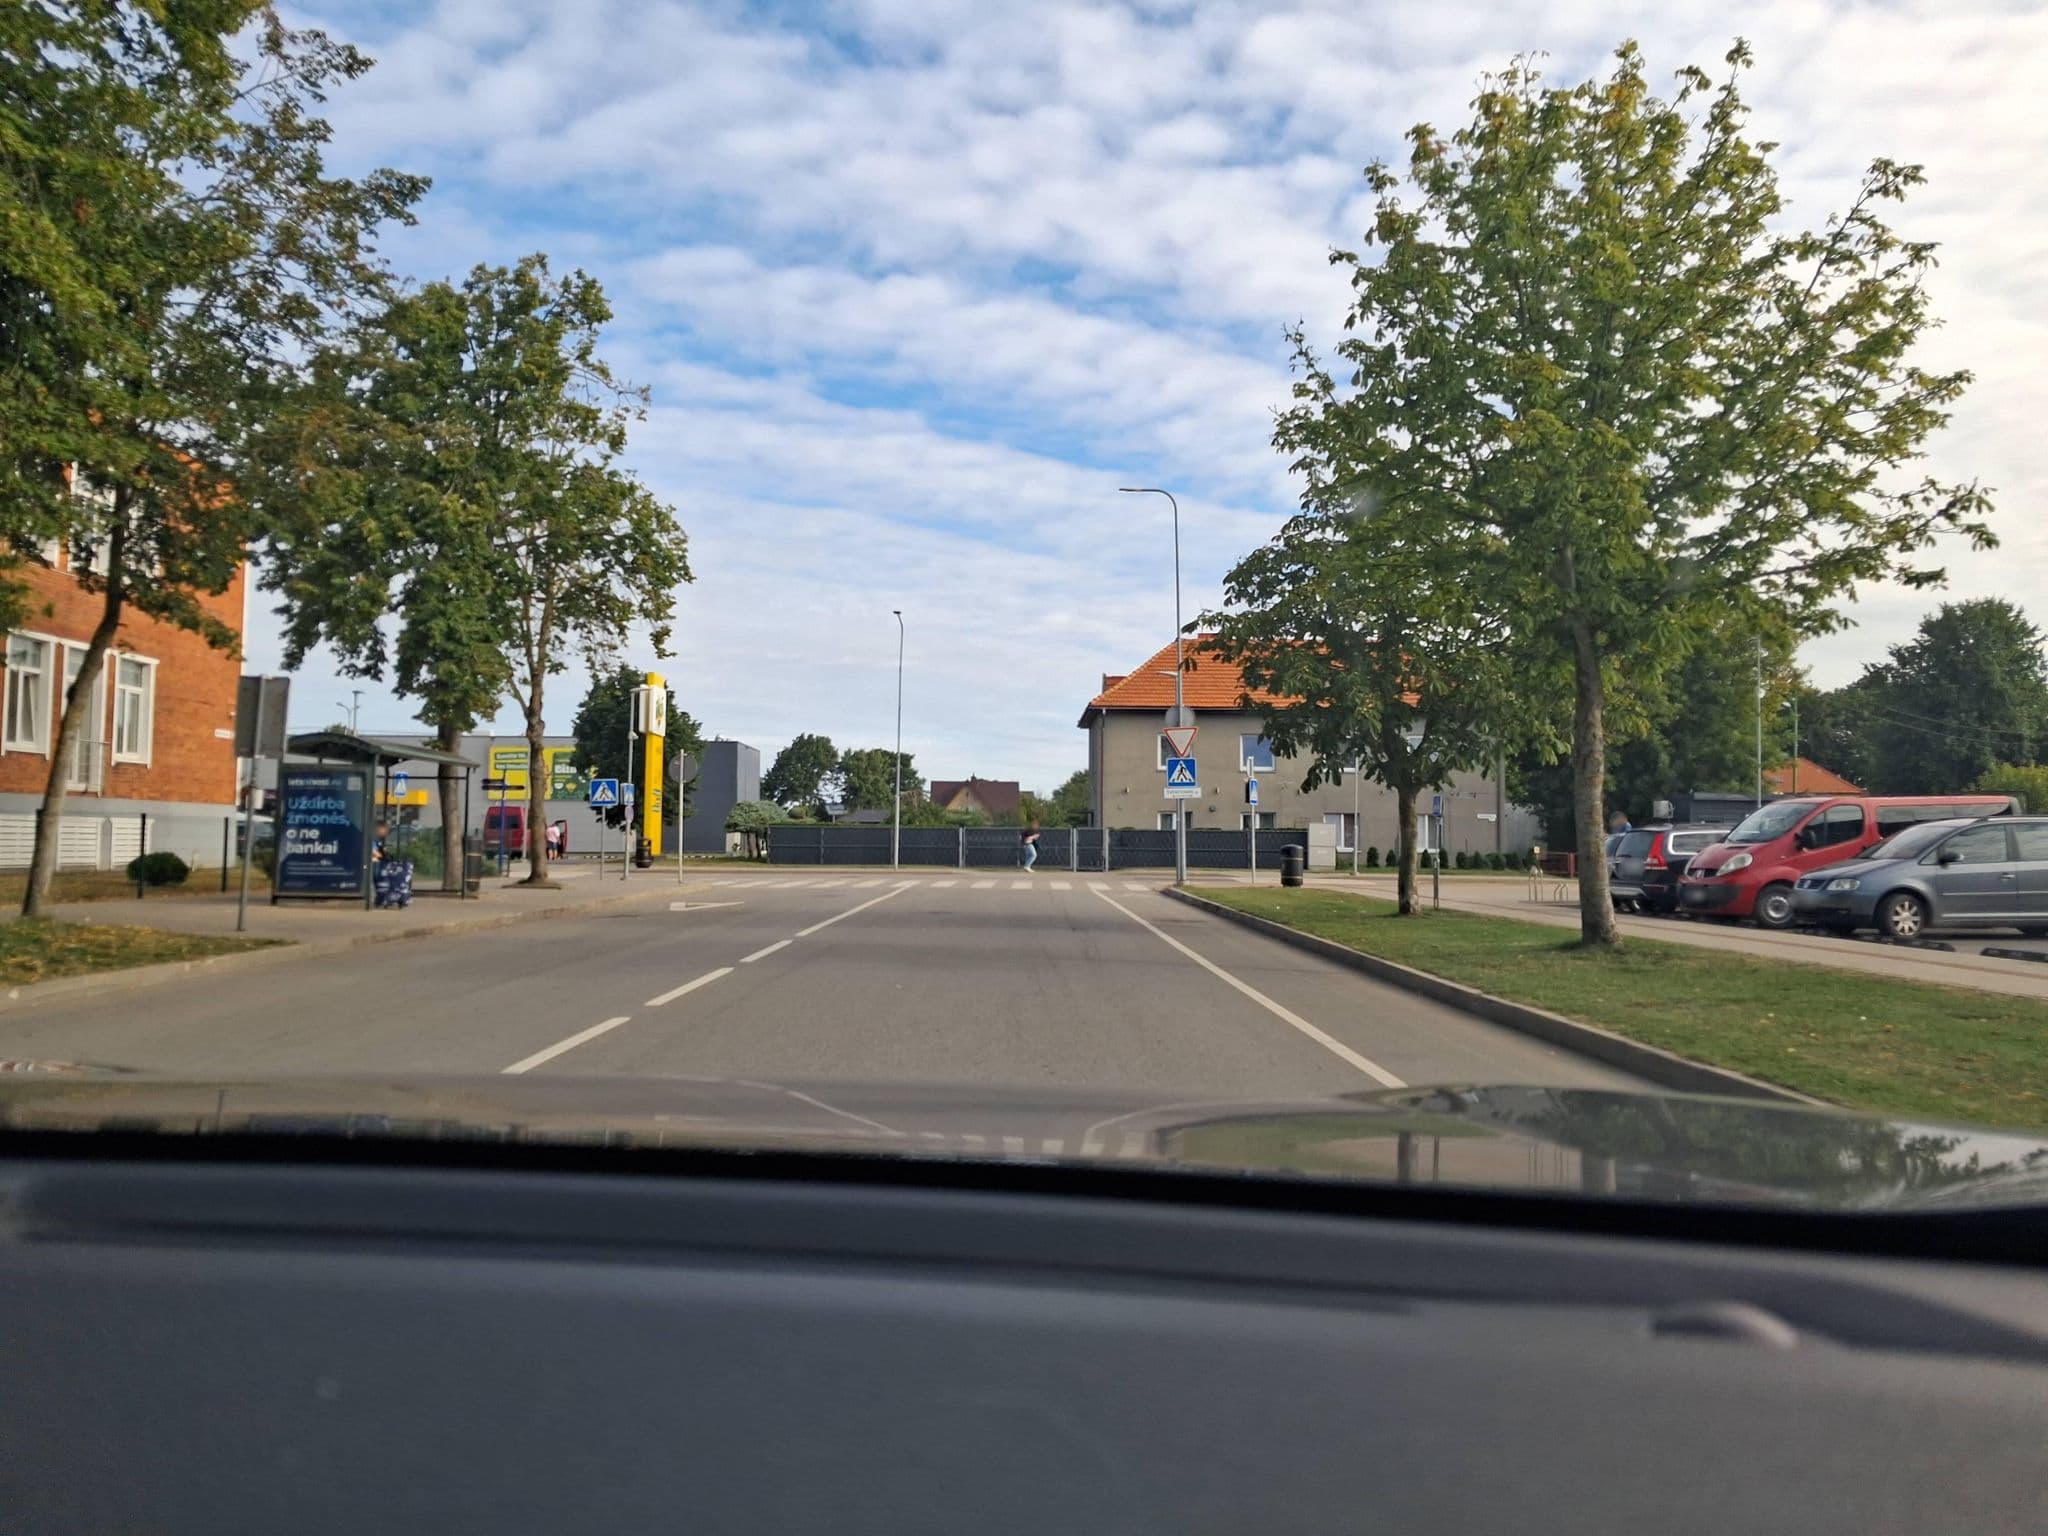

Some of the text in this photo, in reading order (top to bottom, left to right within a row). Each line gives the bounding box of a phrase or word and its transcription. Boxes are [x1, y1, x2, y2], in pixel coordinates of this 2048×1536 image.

[287, 796, 346, 810] Uždirba
[286, 829, 320, 839] o ne
[286, 840, 338, 854] bankai
